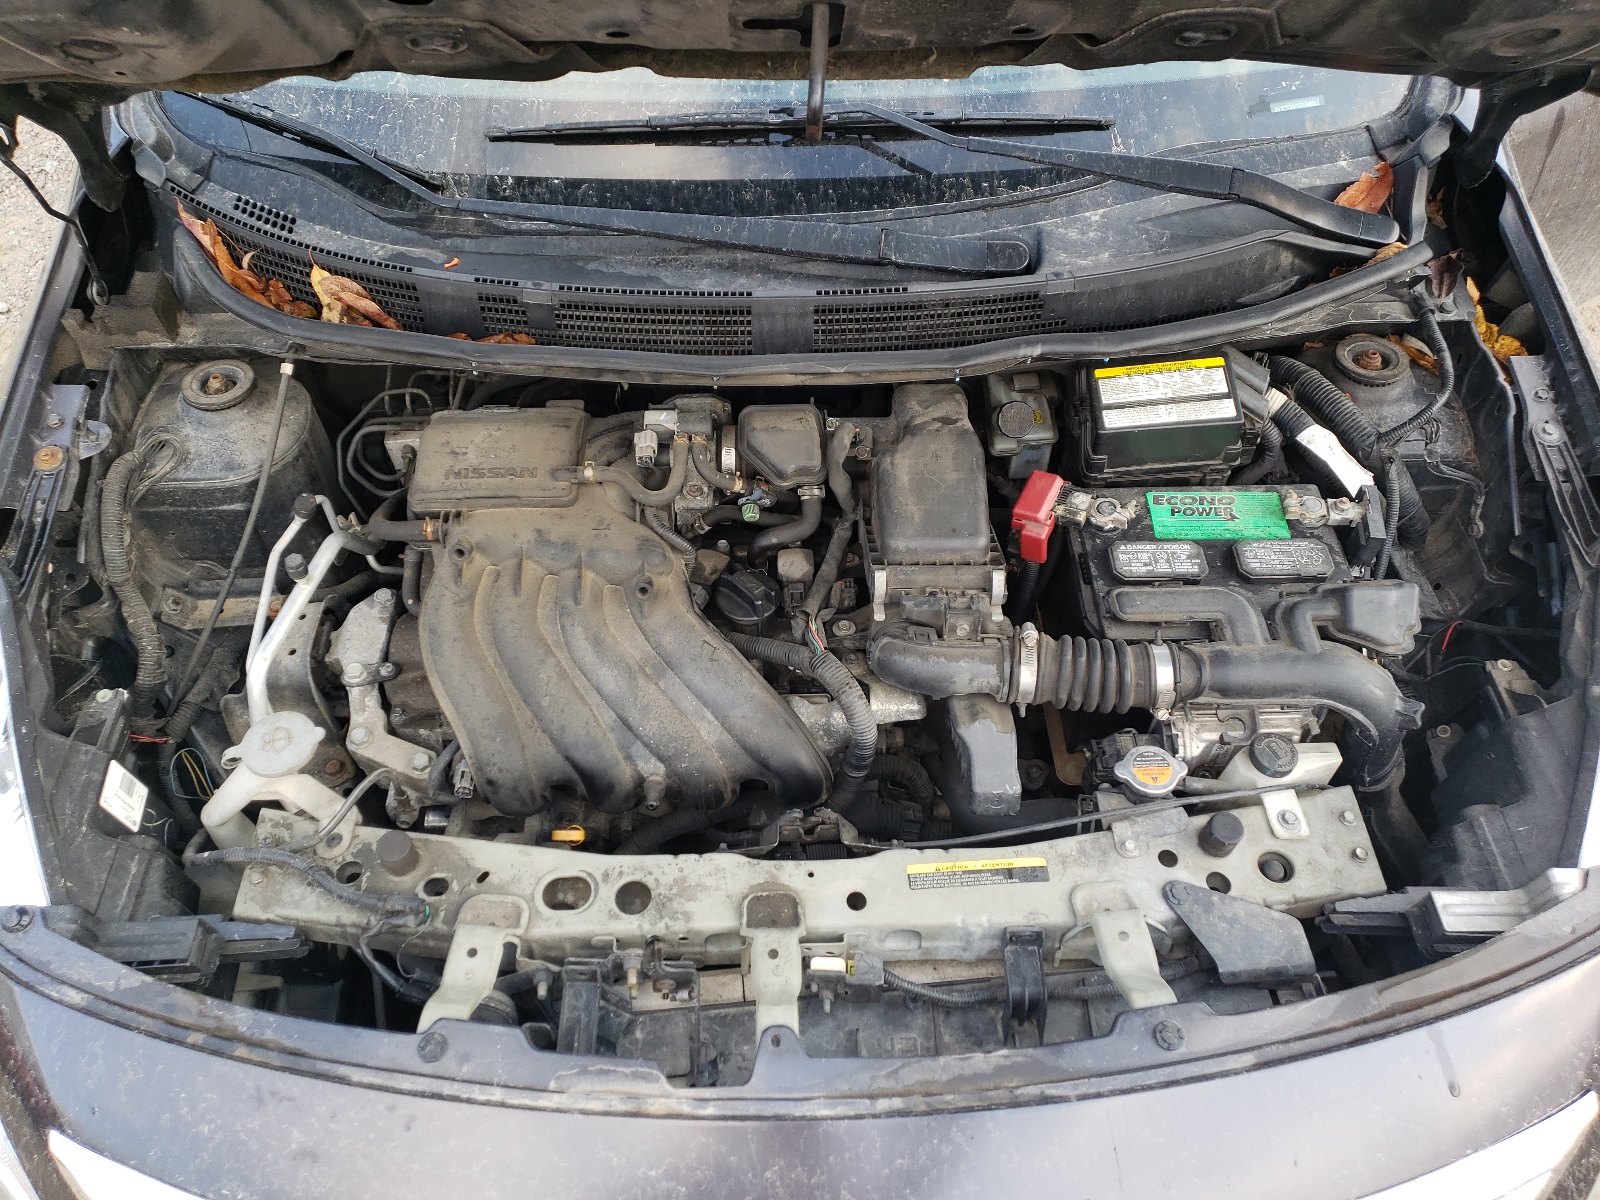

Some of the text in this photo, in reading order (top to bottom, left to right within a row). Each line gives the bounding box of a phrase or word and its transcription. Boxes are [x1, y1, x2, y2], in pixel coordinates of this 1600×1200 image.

[444, 466, 538, 480] NISSAN
[1152, 494, 1237, 506] ECONO
[1170, 506, 1241, 518] POWER
